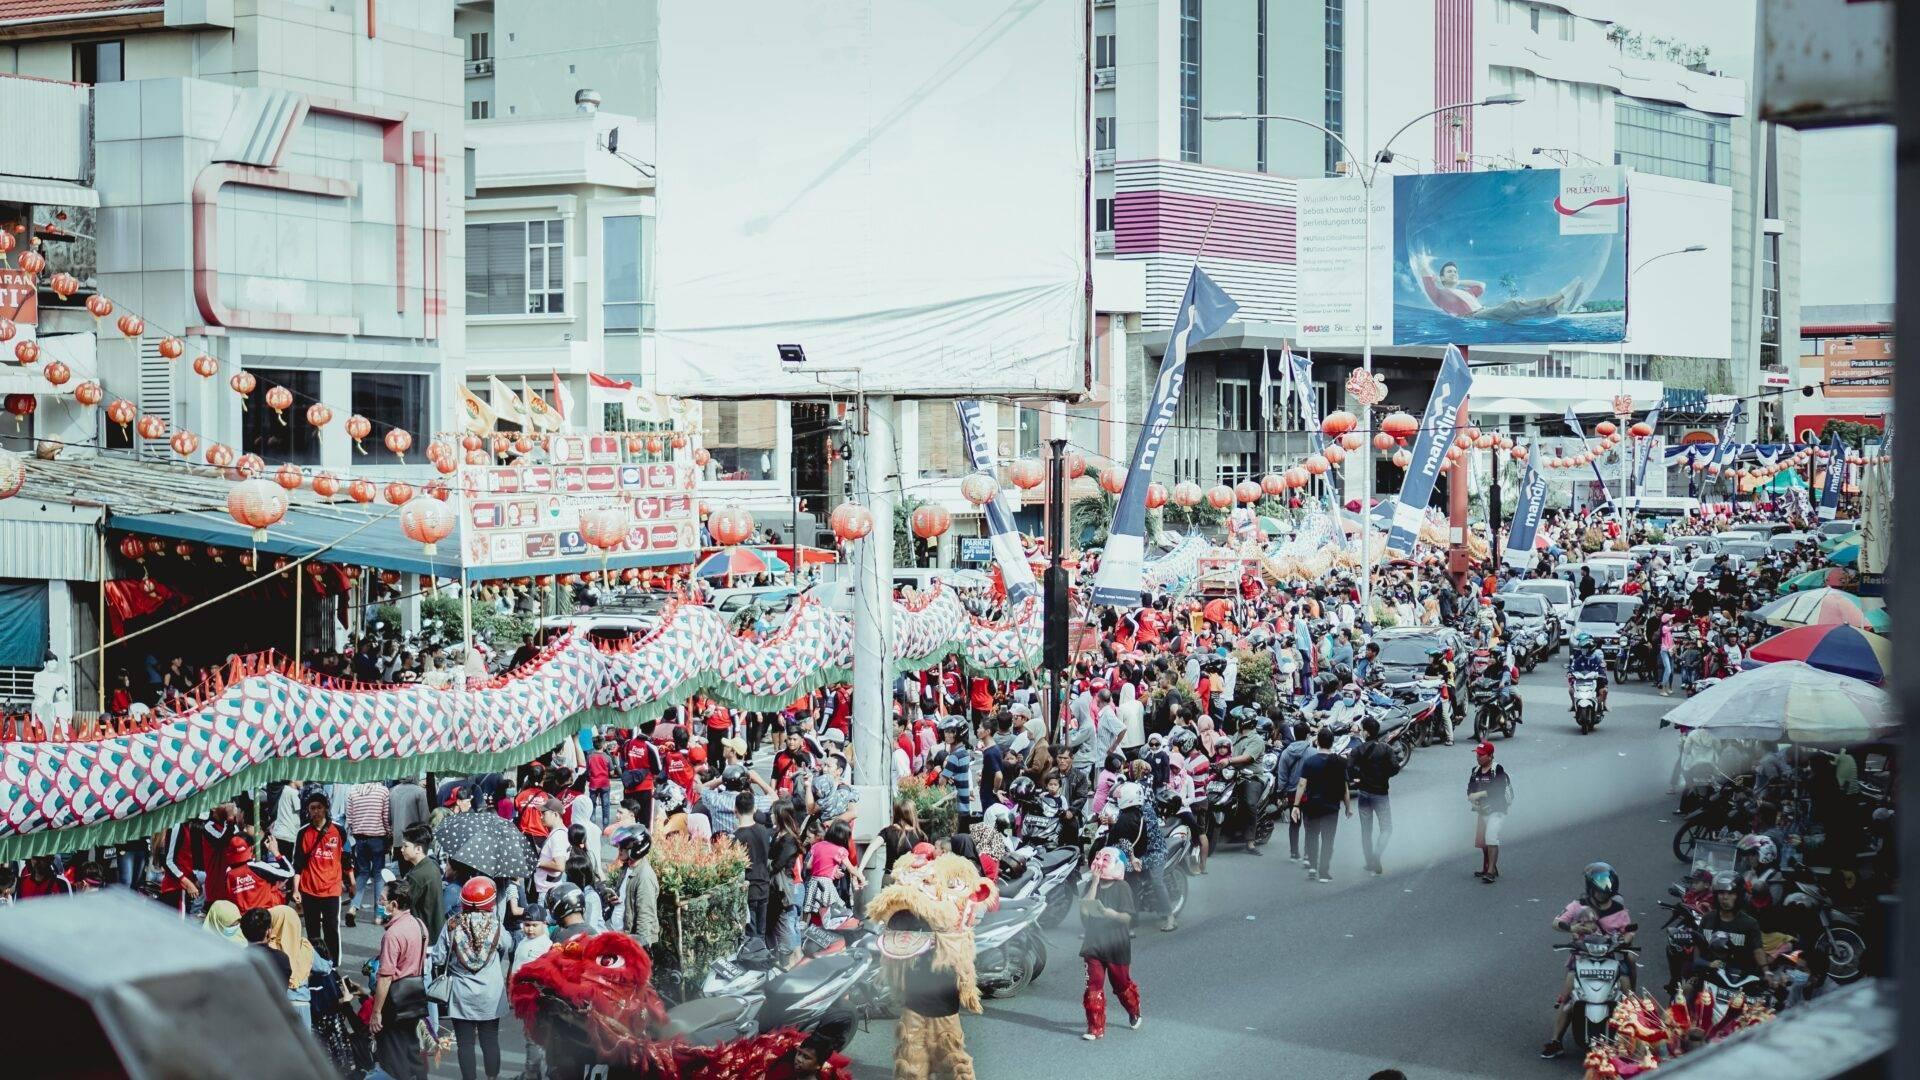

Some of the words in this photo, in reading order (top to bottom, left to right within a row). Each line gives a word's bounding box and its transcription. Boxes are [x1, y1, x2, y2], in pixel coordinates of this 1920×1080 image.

[1566, 185, 1611, 194] PRUDENTIAL
[1340, 193, 1360, 203] hidup
[1303, 207, 1324, 215] bebas
[1422, 405, 1457, 477] mandiri
